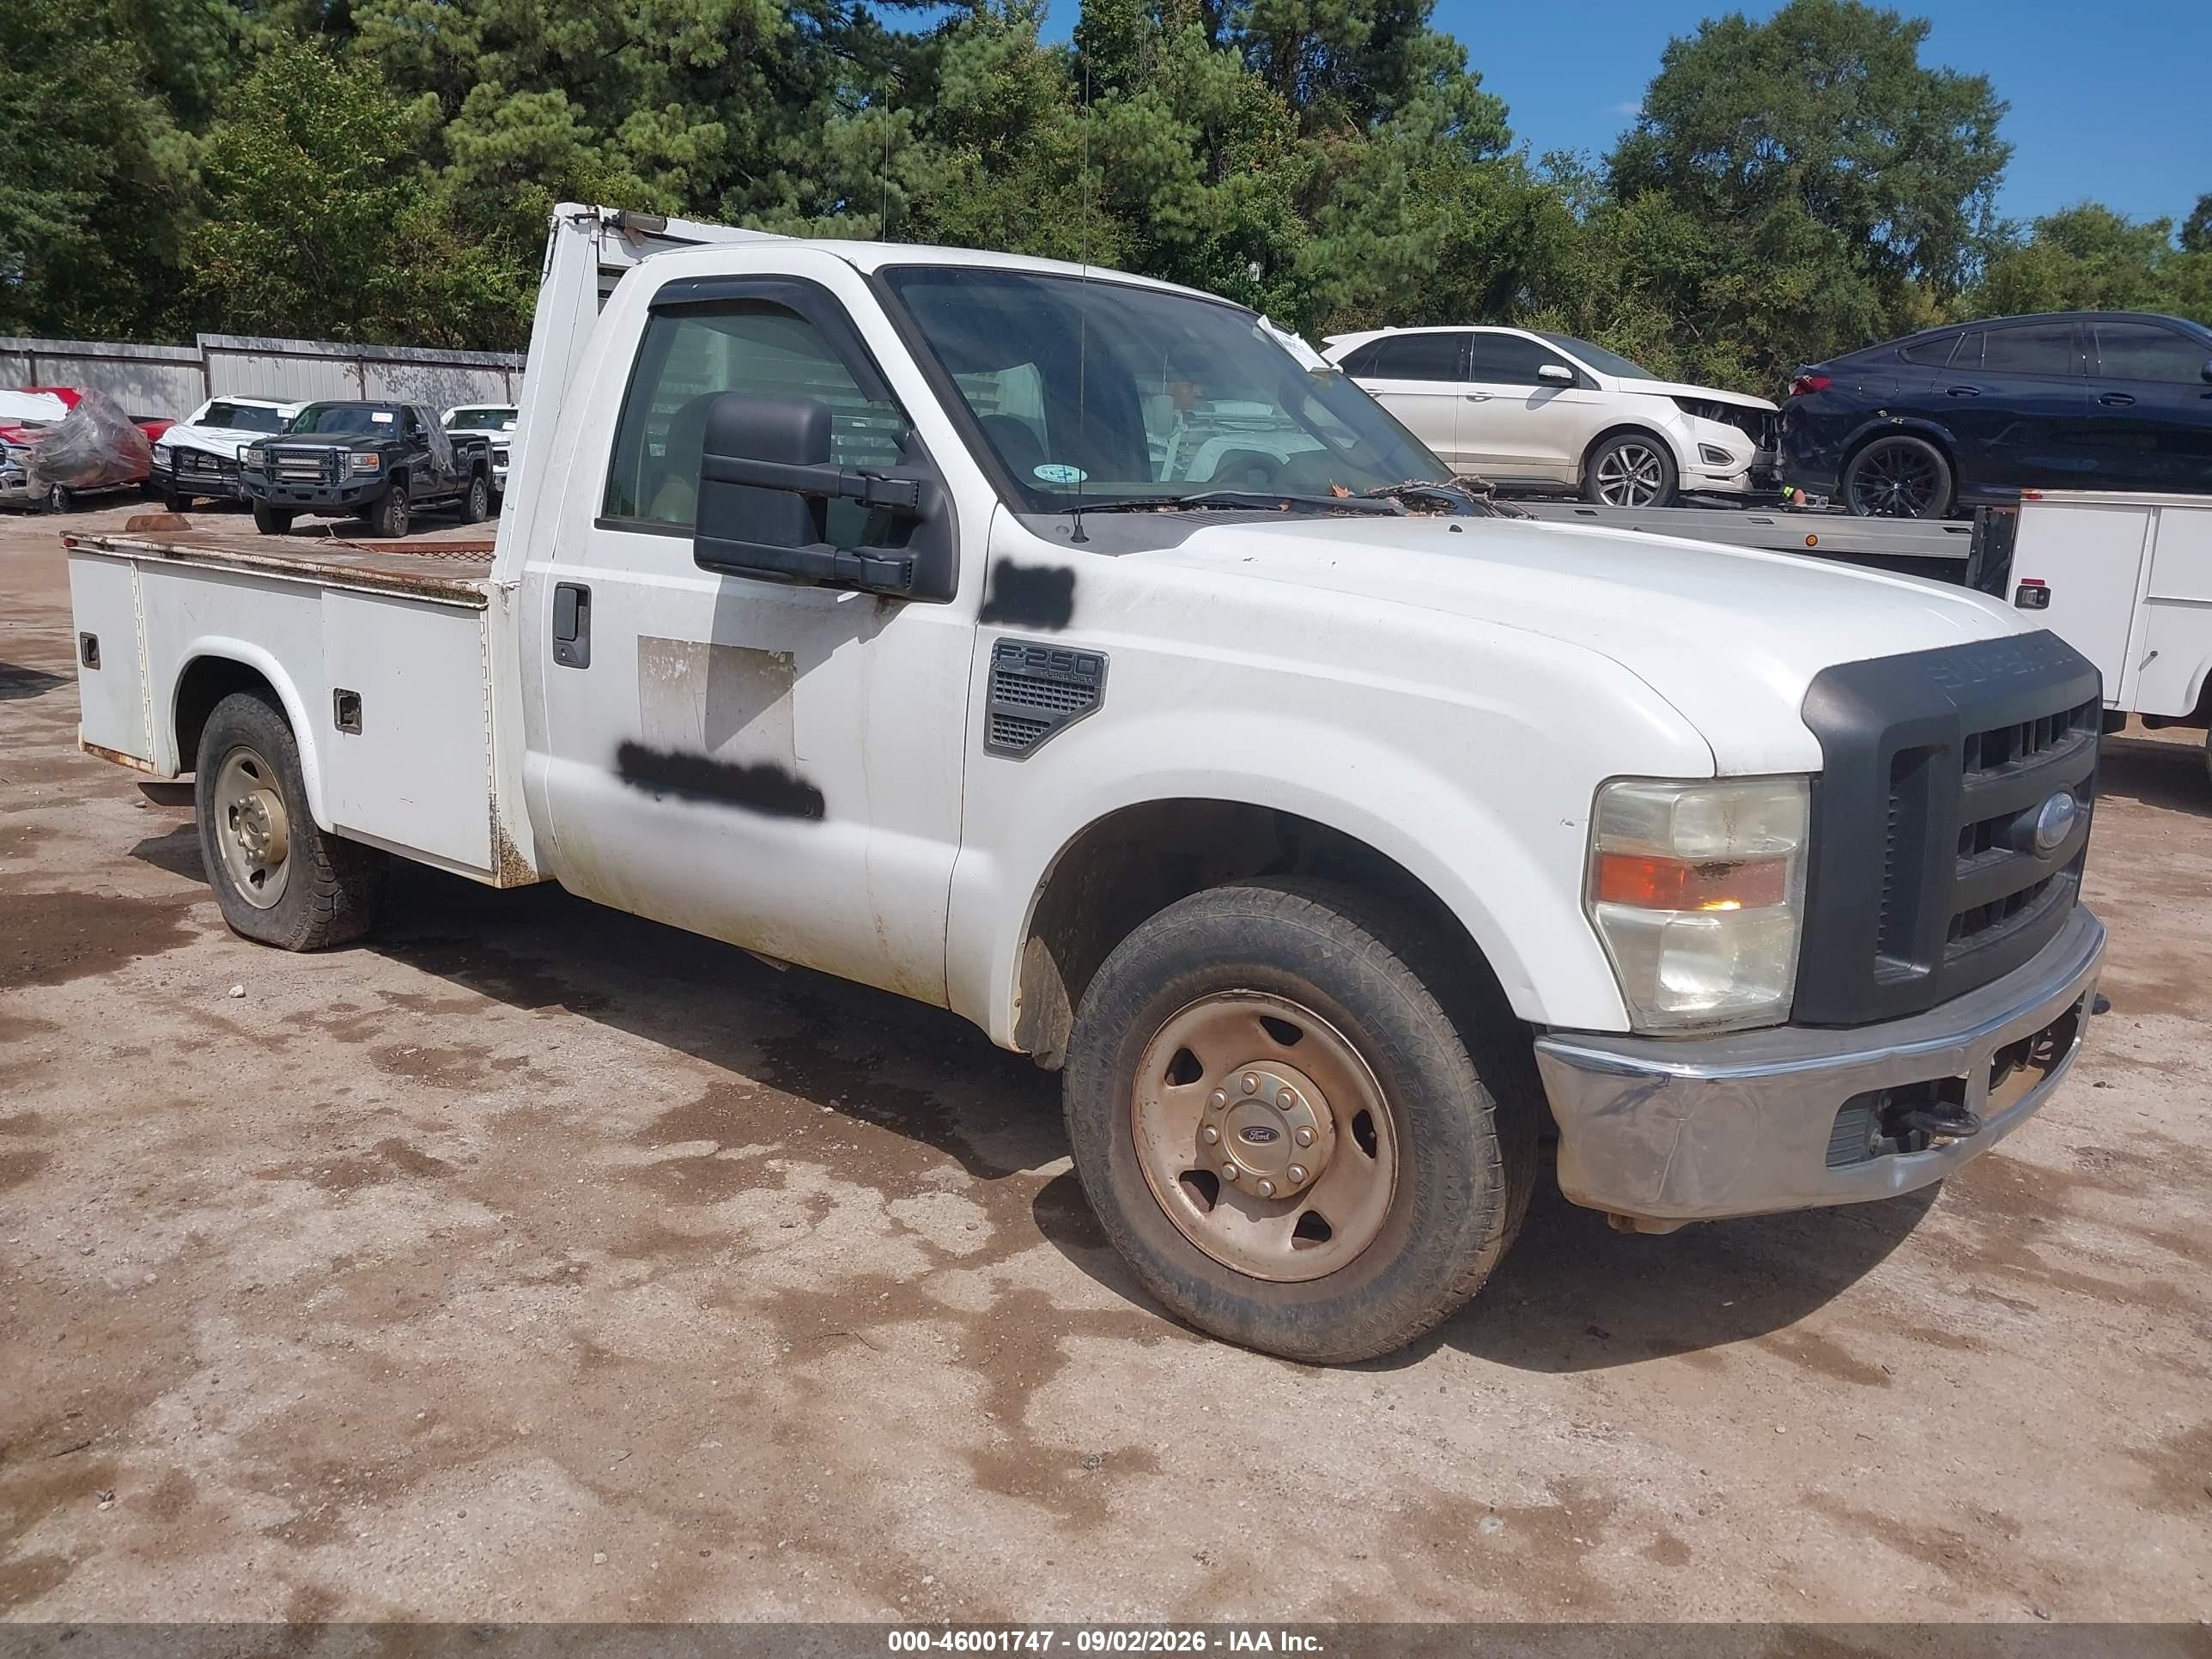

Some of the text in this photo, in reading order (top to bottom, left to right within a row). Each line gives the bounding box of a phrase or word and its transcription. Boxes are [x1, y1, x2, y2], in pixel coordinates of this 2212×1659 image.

[996, 645, 1099, 676] F-250
[1040, 670, 1096, 685] SUPER DUTY
[1249, 1130, 1270, 1140] Ford
